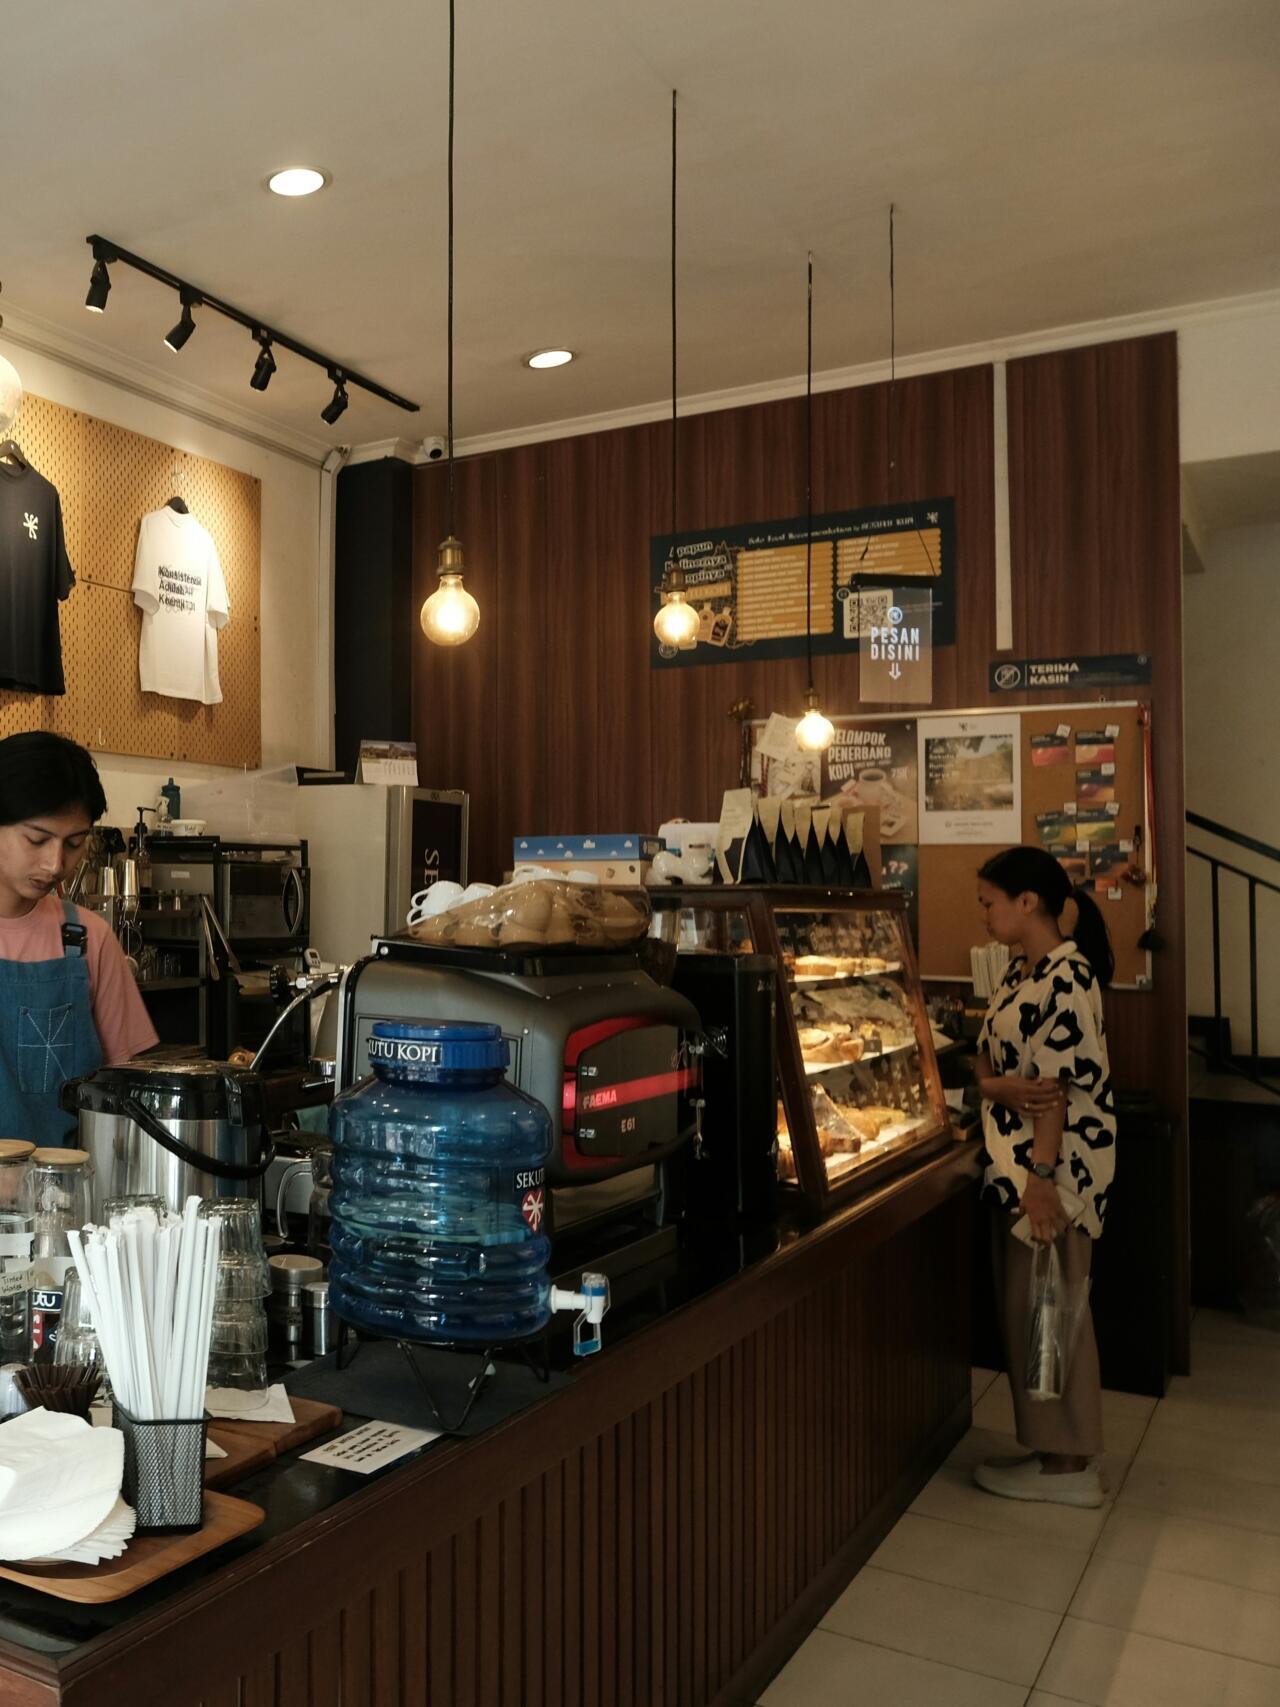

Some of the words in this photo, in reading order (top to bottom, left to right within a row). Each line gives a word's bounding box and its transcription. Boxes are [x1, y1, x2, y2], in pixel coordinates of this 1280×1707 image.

[870, 626, 920, 644] PESAN
[870, 644, 920, 661] DISINI
[1029, 662, 1080, 674] TERIMA
[1029, 674, 1070, 686] KASIH
[828, 762, 855, 781] KOPI
[397, 1043, 438, 1063] KOPI
[582, 1089, 617, 1110] FAEMA
